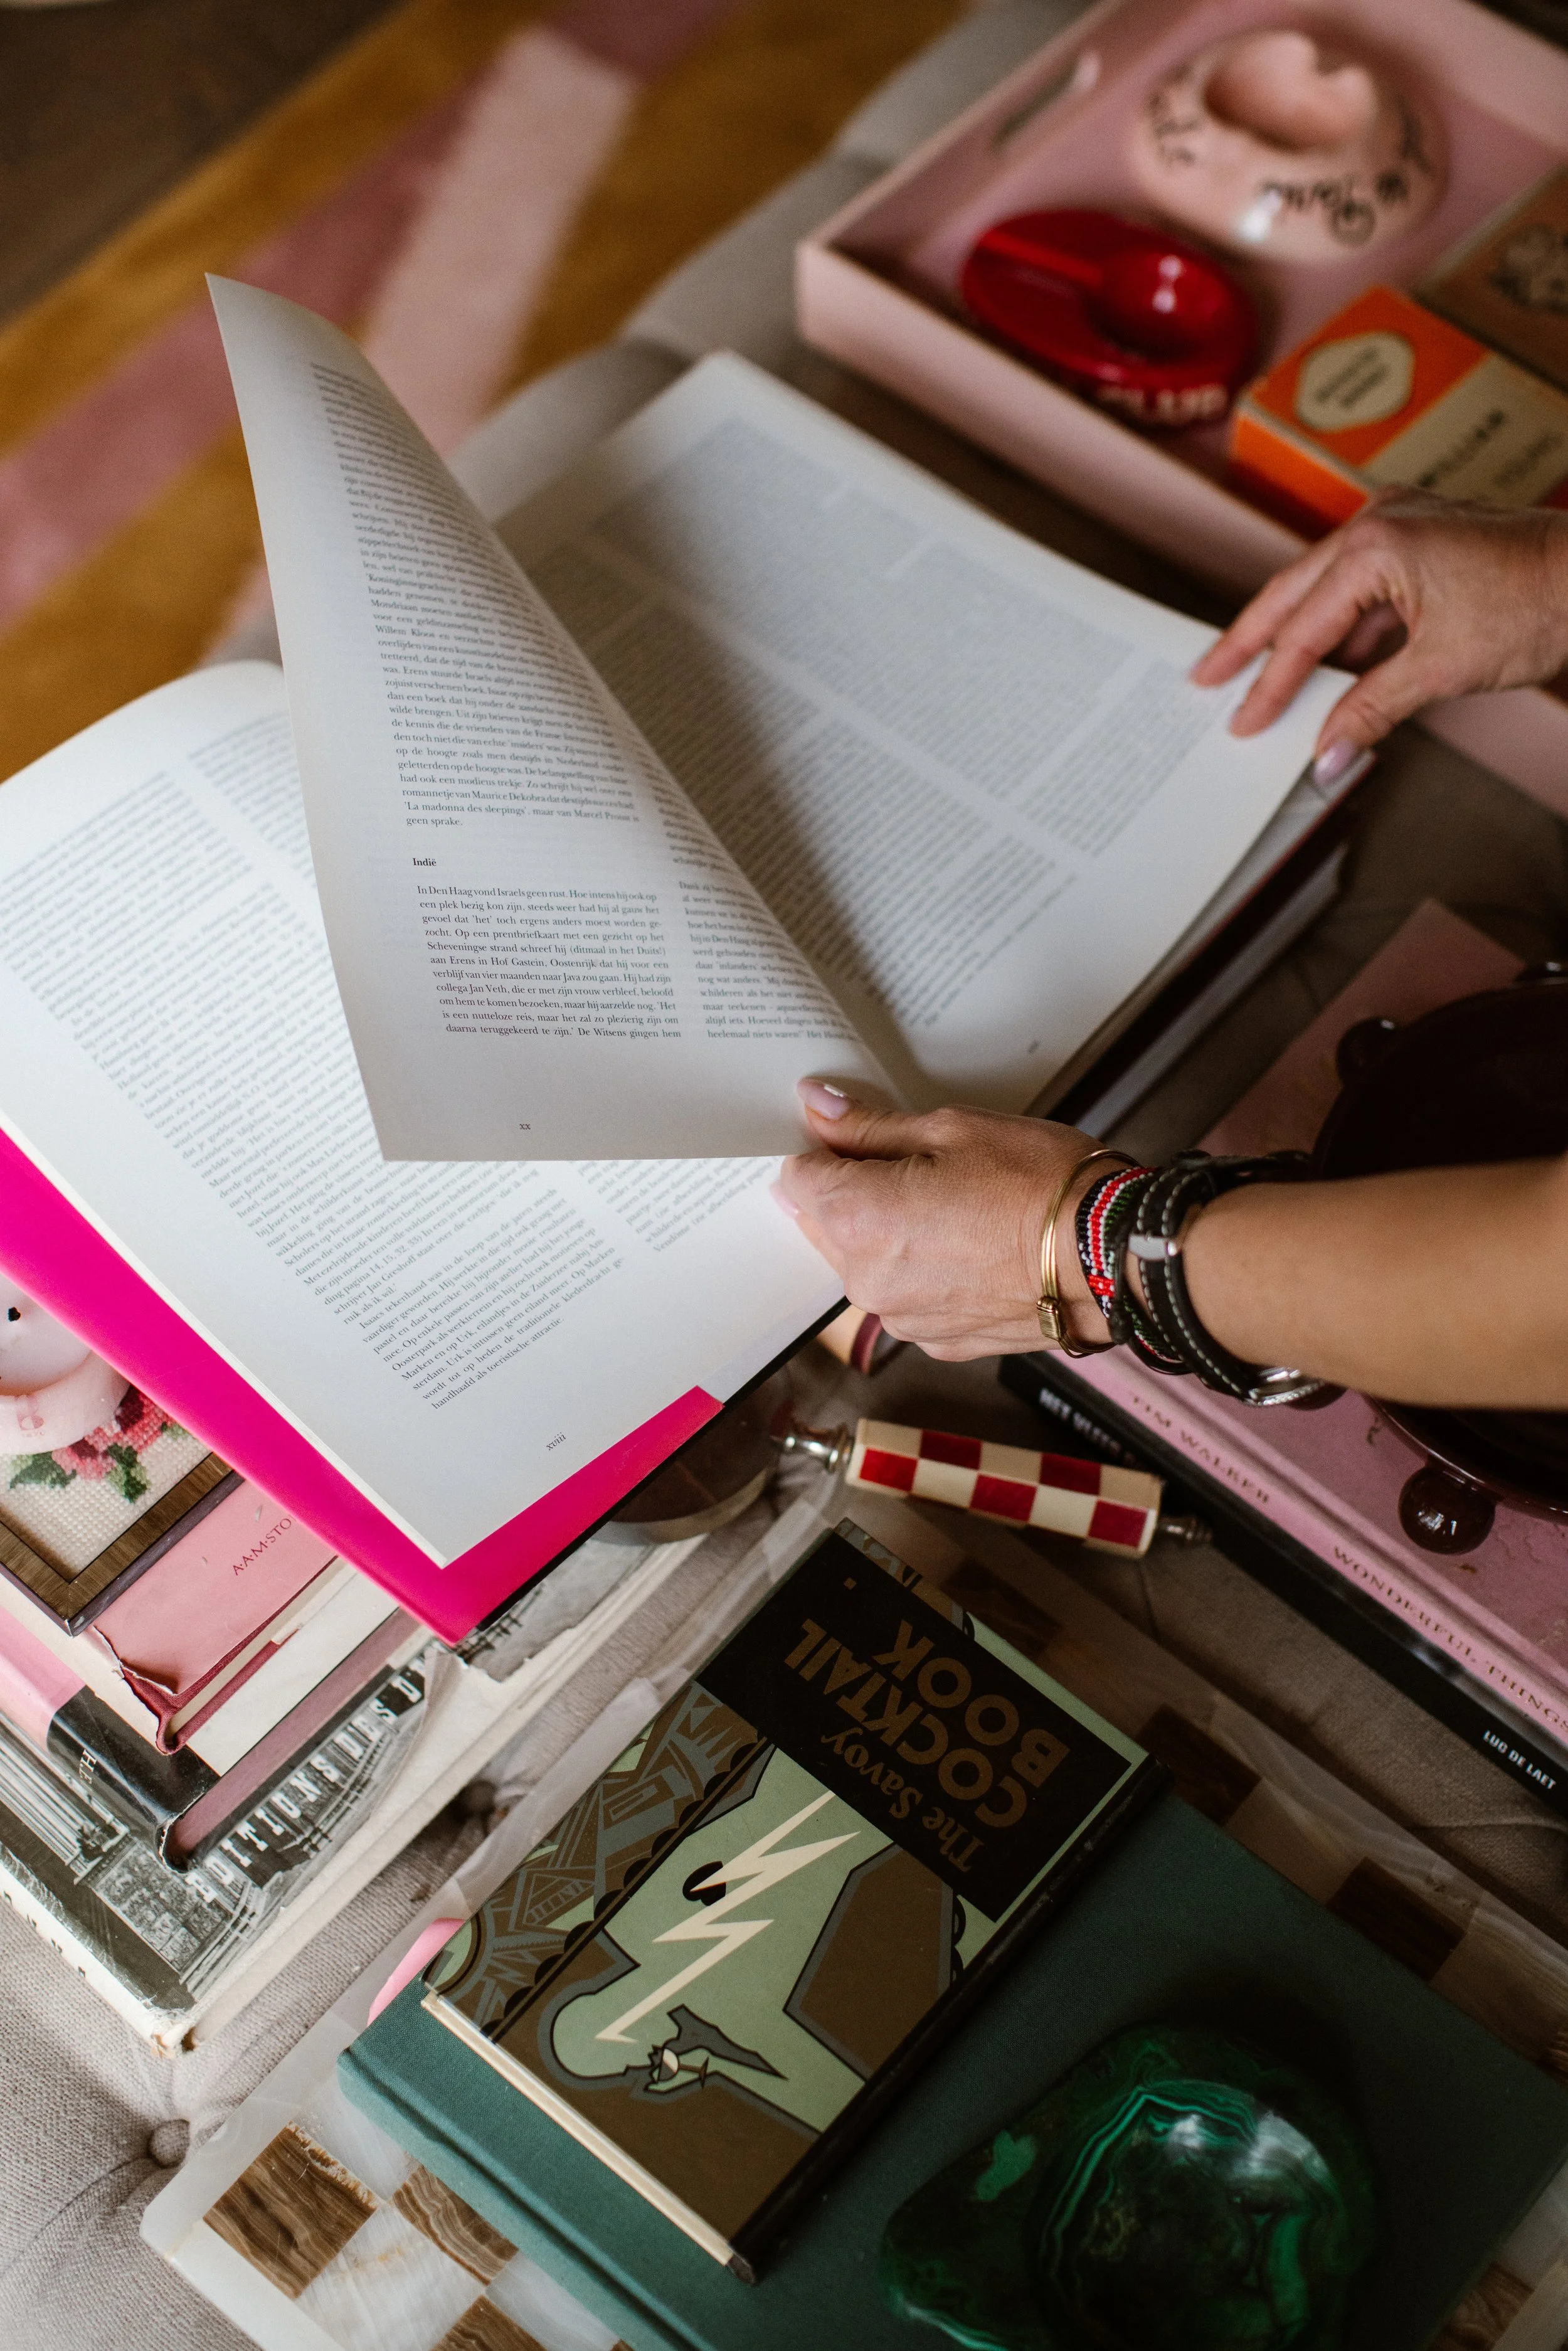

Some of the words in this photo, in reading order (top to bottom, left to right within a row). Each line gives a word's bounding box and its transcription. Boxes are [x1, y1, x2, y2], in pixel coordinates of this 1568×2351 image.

[472, 790, 507, 801] Maurice
[422, 802, 465, 812] madonna
[467, 804, 482, 812] des
[406, 817, 428, 827] geen
[431, 817, 463, 827] sprake.
[413, 857, 437, 867] Indië
[429, 886, 447, 894] Den
[449, 887, 472, 898] Haag
[474, 888, 495, 896] vond
[497, 888, 525, 896] Israels
[527, 891, 547, 900] geen
[569, 890, 587, 898] Hoe
[590, 891, 615, 899] intens
[617, 891, 627, 901] hij
[629, 891, 645, 900] ook
[439, 900, 458, 911] plek
[461, 901, 484, 911] bezig
[487, 901, 503, 910] kon
[506, 902, 525, 913] zijn,
[527, 903, 554, 911] steeds
[580, 904, 595, 912] had
[598, 904, 610, 915] hij
[612, 905, 619, 913] al
[646, 905, 659, 913] het
[422, 915, 451, 925] gevoel
[455, 915, 469, 923] dat
[497, 916, 516, 924] toch
[520, 919, 549, 927] ergens
[553, 917, 581, 925] anders
[614, 918, 645, 926] worden
[650, 921, 662, 930] ge-
[425, 928, 452, 936] zocht.
[455, 929, 470, 939] Op
[493, 930, 559, 941] prentbriefkaart
[602, 932, 632, 942] gezicht
[650, 933, 664, 941] het
[427, 942, 487, 953] Scheveningse
[490, 943, 517, 952] strand
[521, 945, 552, 953] schreef
[554, 945, 566, 955] hij
[570, 945, 606, 956] (ditmaal
[620, 946, 633, 954] het
[450, 957, 475, 965] Erens
[491, 957, 509, 965] Hof
[511, 958, 547, 968] Gastein,
[550, 958, 596, 969] Oostenrijk
[600, 959, 613, 967] dat
[617, 960, 627, 970] hij
[433, 970, 465, 980] verblijf
[482, 971, 499, 979] vier
[501, 972, 541, 980] maanden
[563, 973, 581, 983] Java
[623, 974, 637, 984] Hij
[638, 974, 654, 982] had
[657, 974, 671, 985] zijn
[437, 983, 468, 994] collega
[469, 984, 484, 994] Jan
[485, 984, 509, 994] Veth,
[512, 985, 526, 993] die
[558, 987, 572, 997] zijn
[602, 987, 639, 997] verbleef,
[641, 988, 673, 996] beloofd
[455, 997, 475, 1005] hem
[487, 998, 517, 1006] komen
[519, 999, 563, 1009] bezoeken,
[587, 1000, 598, 1011] hij
[600, 1001, 635, 1009] aarzelde
[472, 1011, 513, 1020] nutteloze
[516, 1012, 534, 1022] reis,
[562, 1014, 576, 1022] het
[580, 1014, 591, 1022] zal
[608, 1014, 644, 1025] plezierig
[647, 1016, 662, 1026] zijn
[447, 1024, 477, 1032] daarna
[480, 1025, 538, 1036] teruggekeerd
[630, 1029, 659, 1039] gingen
[662, 1029, 681, 1037] hem
[519, 1122, 531, 1130] xx
[422, 1381, 447, 1401] wordt
[448, 1371, 462, 1384] tot
[463, 1362, 475, 1374] op
[476, 1342, 502, 1363] heden
[504, 1333, 516, 1344] de
[517, 1302, 561, 1335] traditionele
[561, 1266, 611, 1303] klederdracht
[431, 1377, 476, 1410] handhaafd
[475, 1370, 488, 1381] als
[487, 1340, 531, 1372] toeristische
[531, 1317, 565, 1342] attractie.
[546, 1430, 568, 1451] xviii
[1128, 1391, 1172, 1428] TIM
[1180, 1429, 1271, 1505] WALKER
[1333, 1545, 1477, 1665] WONDERFUL
[872, 1620, 1071, 1788] BOOK
[784, 1618, 1027, 1828] COCKTAIL
[1483, 1729, 1508, 1754] LUC
[1508, 1747, 1527, 1768] DE
[1525, 1762, 1557, 1790] LAET
[820, 1726, 924, 1819] Savoy
[921, 1807, 985, 1873] The
